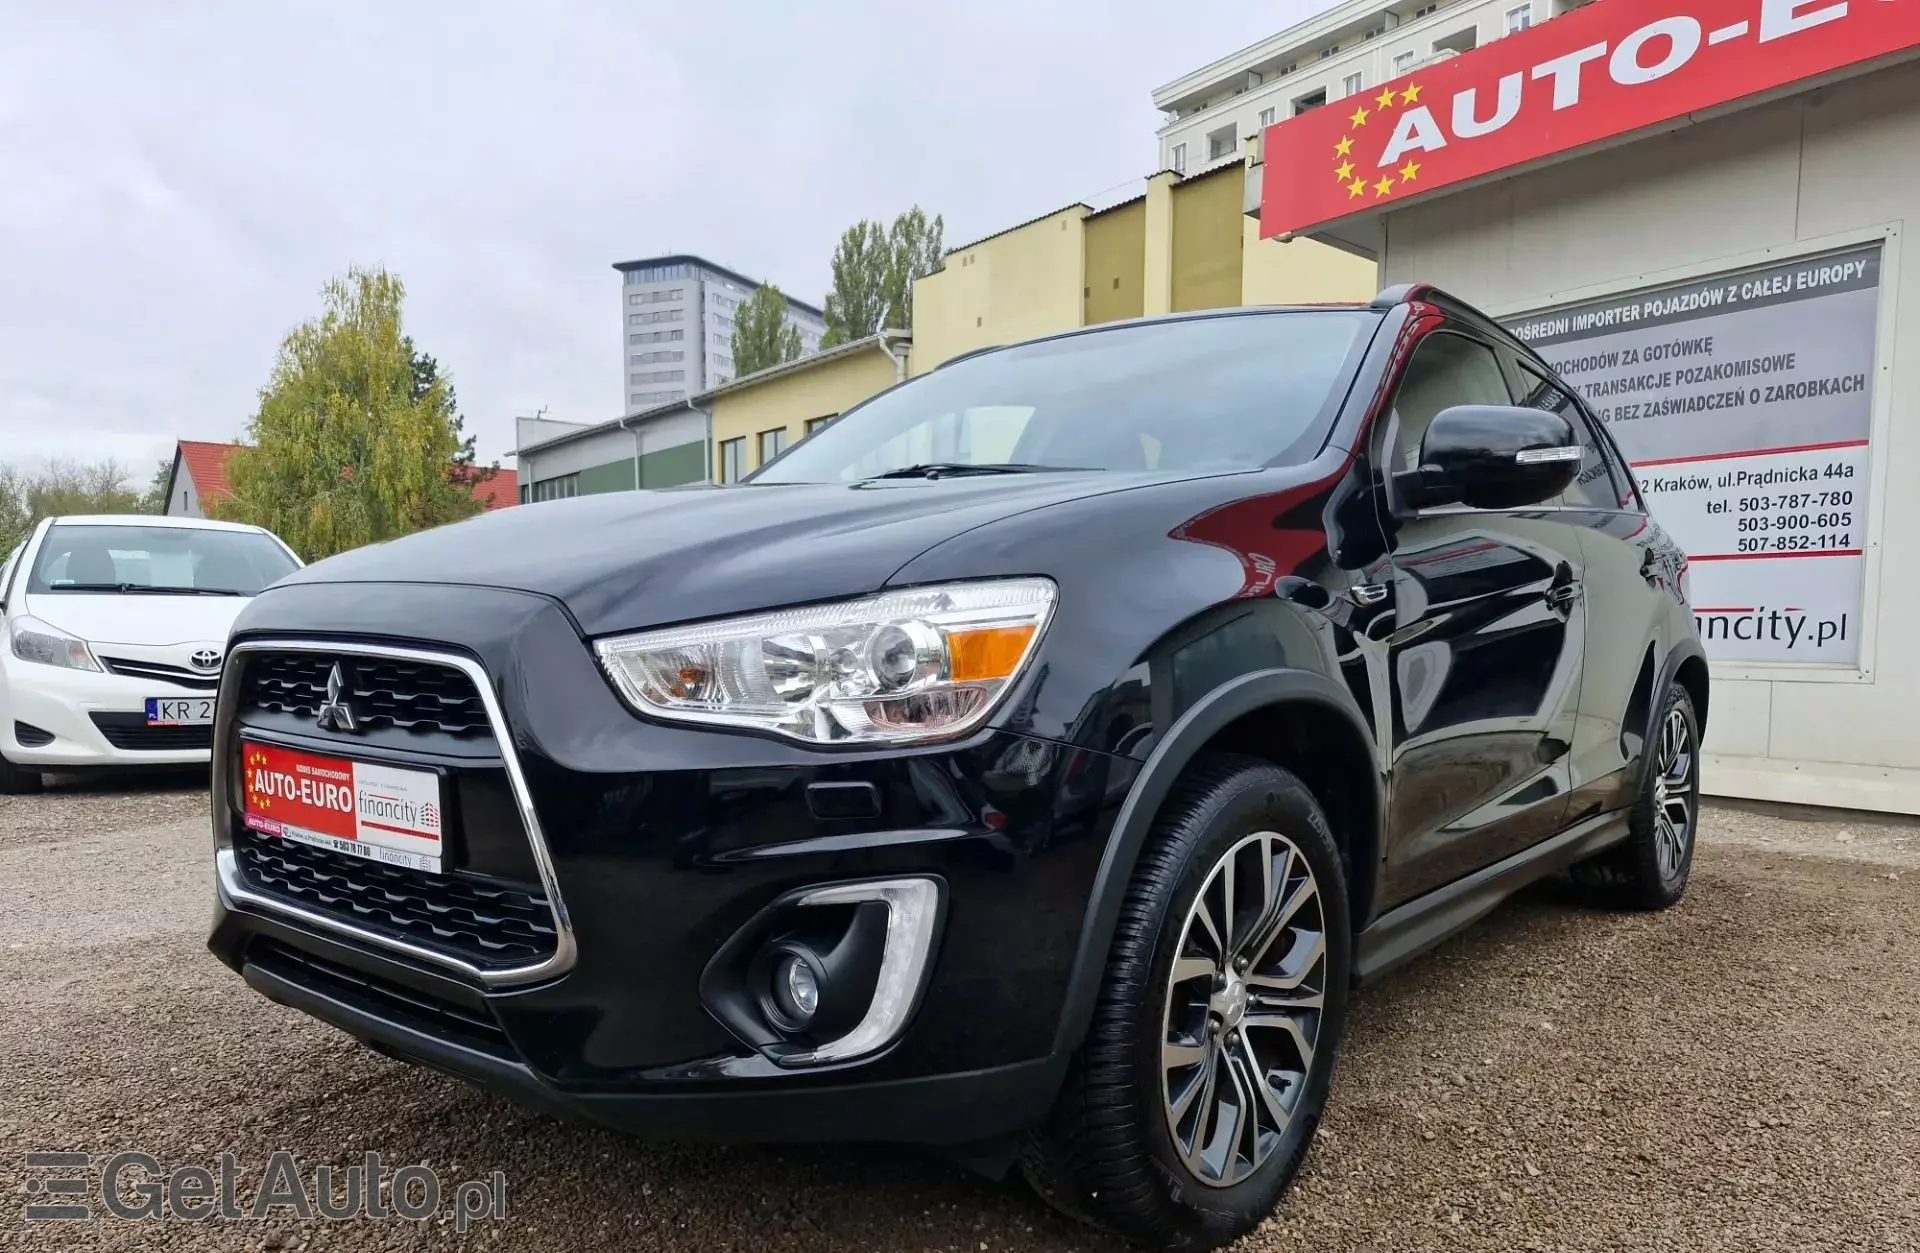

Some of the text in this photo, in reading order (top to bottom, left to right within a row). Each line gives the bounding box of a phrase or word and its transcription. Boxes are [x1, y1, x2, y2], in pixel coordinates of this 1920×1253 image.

[1377, 0, 1897, 168] AUTO-E
[1572, 303, 1640, 331] IMPORTER
[1643, 290, 1723, 317] POJAZDÓW
[1727, 286, 1737, 303] Z
[1741, 275, 1792, 299] CAŁEJ
[1797, 259, 1868, 289] EUROPY
[1549, 336, 1714, 376] OCHODÓW ZA GOTÓWKĘ
[1585, 372, 1671, 400] TRANSAKCJE
[1675, 352, 1796, 386] POZAKOMISOWE
[1598, 373, 1865, 423] G BEZ ZAŚWIADCZEŃ O ZAROBKACH
[1653, 473, 1713, 494] Kraków,
[1717, 465, 1818, 490] ul.Prądnicka
[1823, 462, 1854, 479] 44a
[1706, 490, 1853, 514] tel. 503-787-780
[1737, 512, 1852, 532] 503-900-605
[1737, 533, 1850, 552] 507-852-114
[162, 701, 215, 720] KR 2
[254, 768, 352, 813] AUTO-EURO
[359, 789, 417, 828] financity
